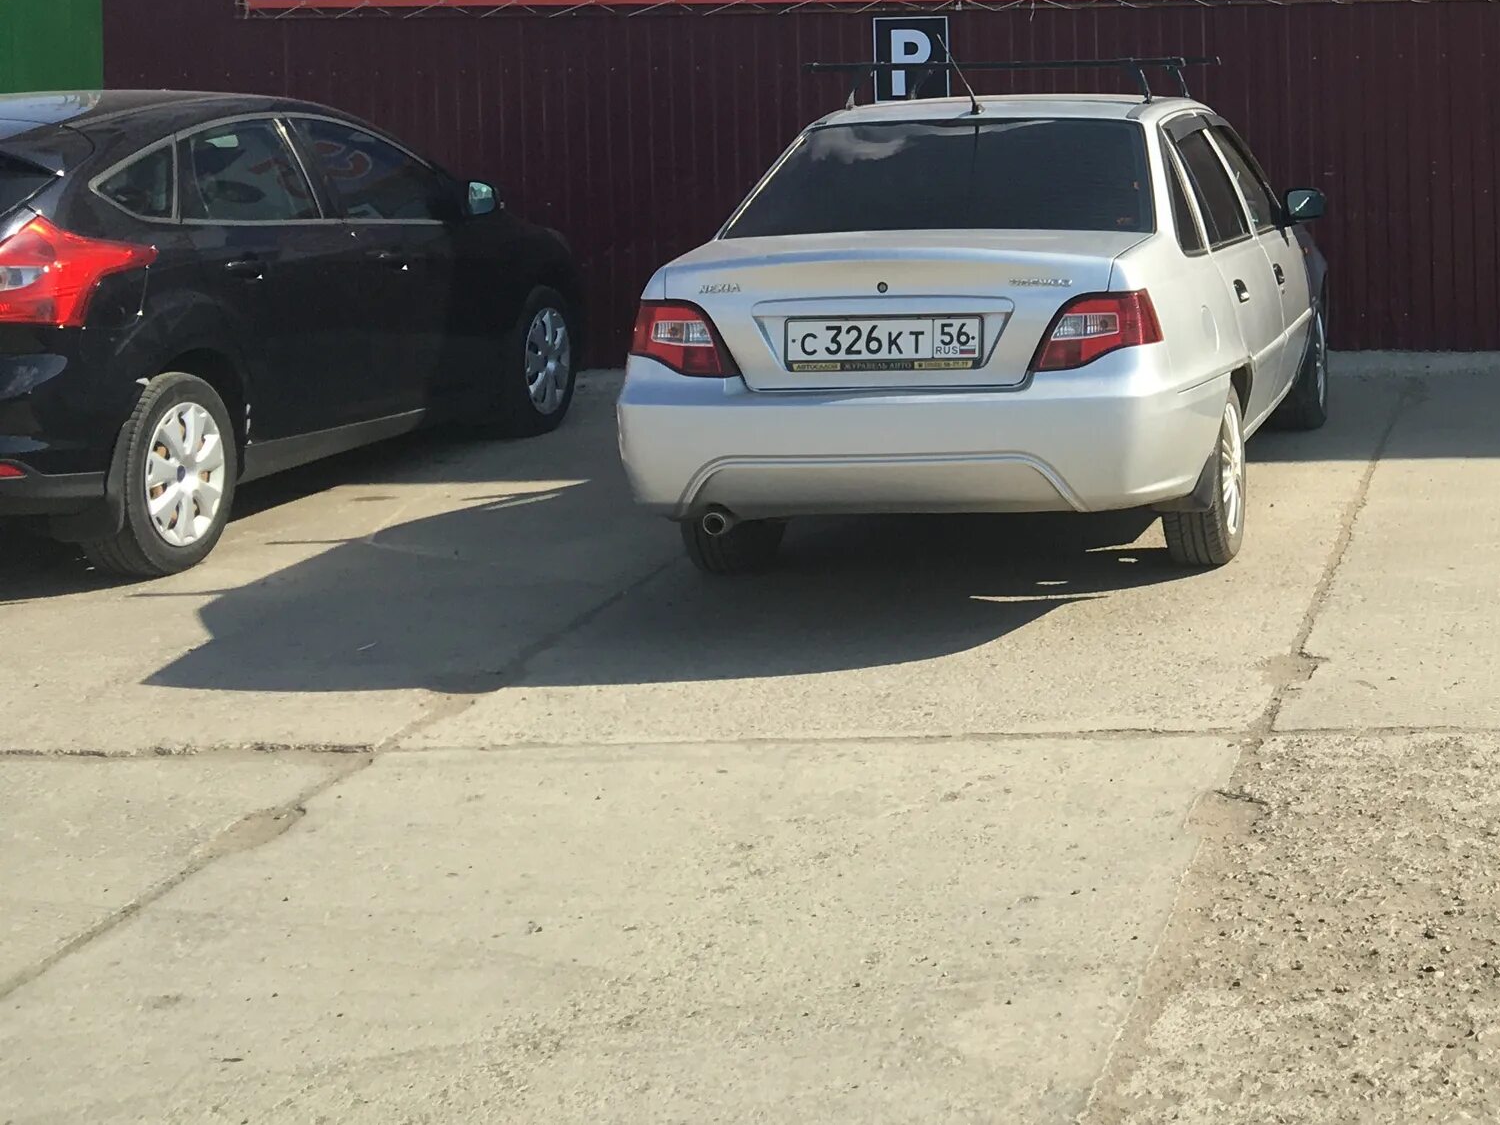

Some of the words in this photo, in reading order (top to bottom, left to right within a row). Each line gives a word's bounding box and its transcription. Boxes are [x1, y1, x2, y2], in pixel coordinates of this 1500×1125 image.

[891, 28, 932, 96] P
[699, 283, 741, 294] NEXIA
[939, 322, 971, 347] 56
[935, 345, 959, 355] RUS
